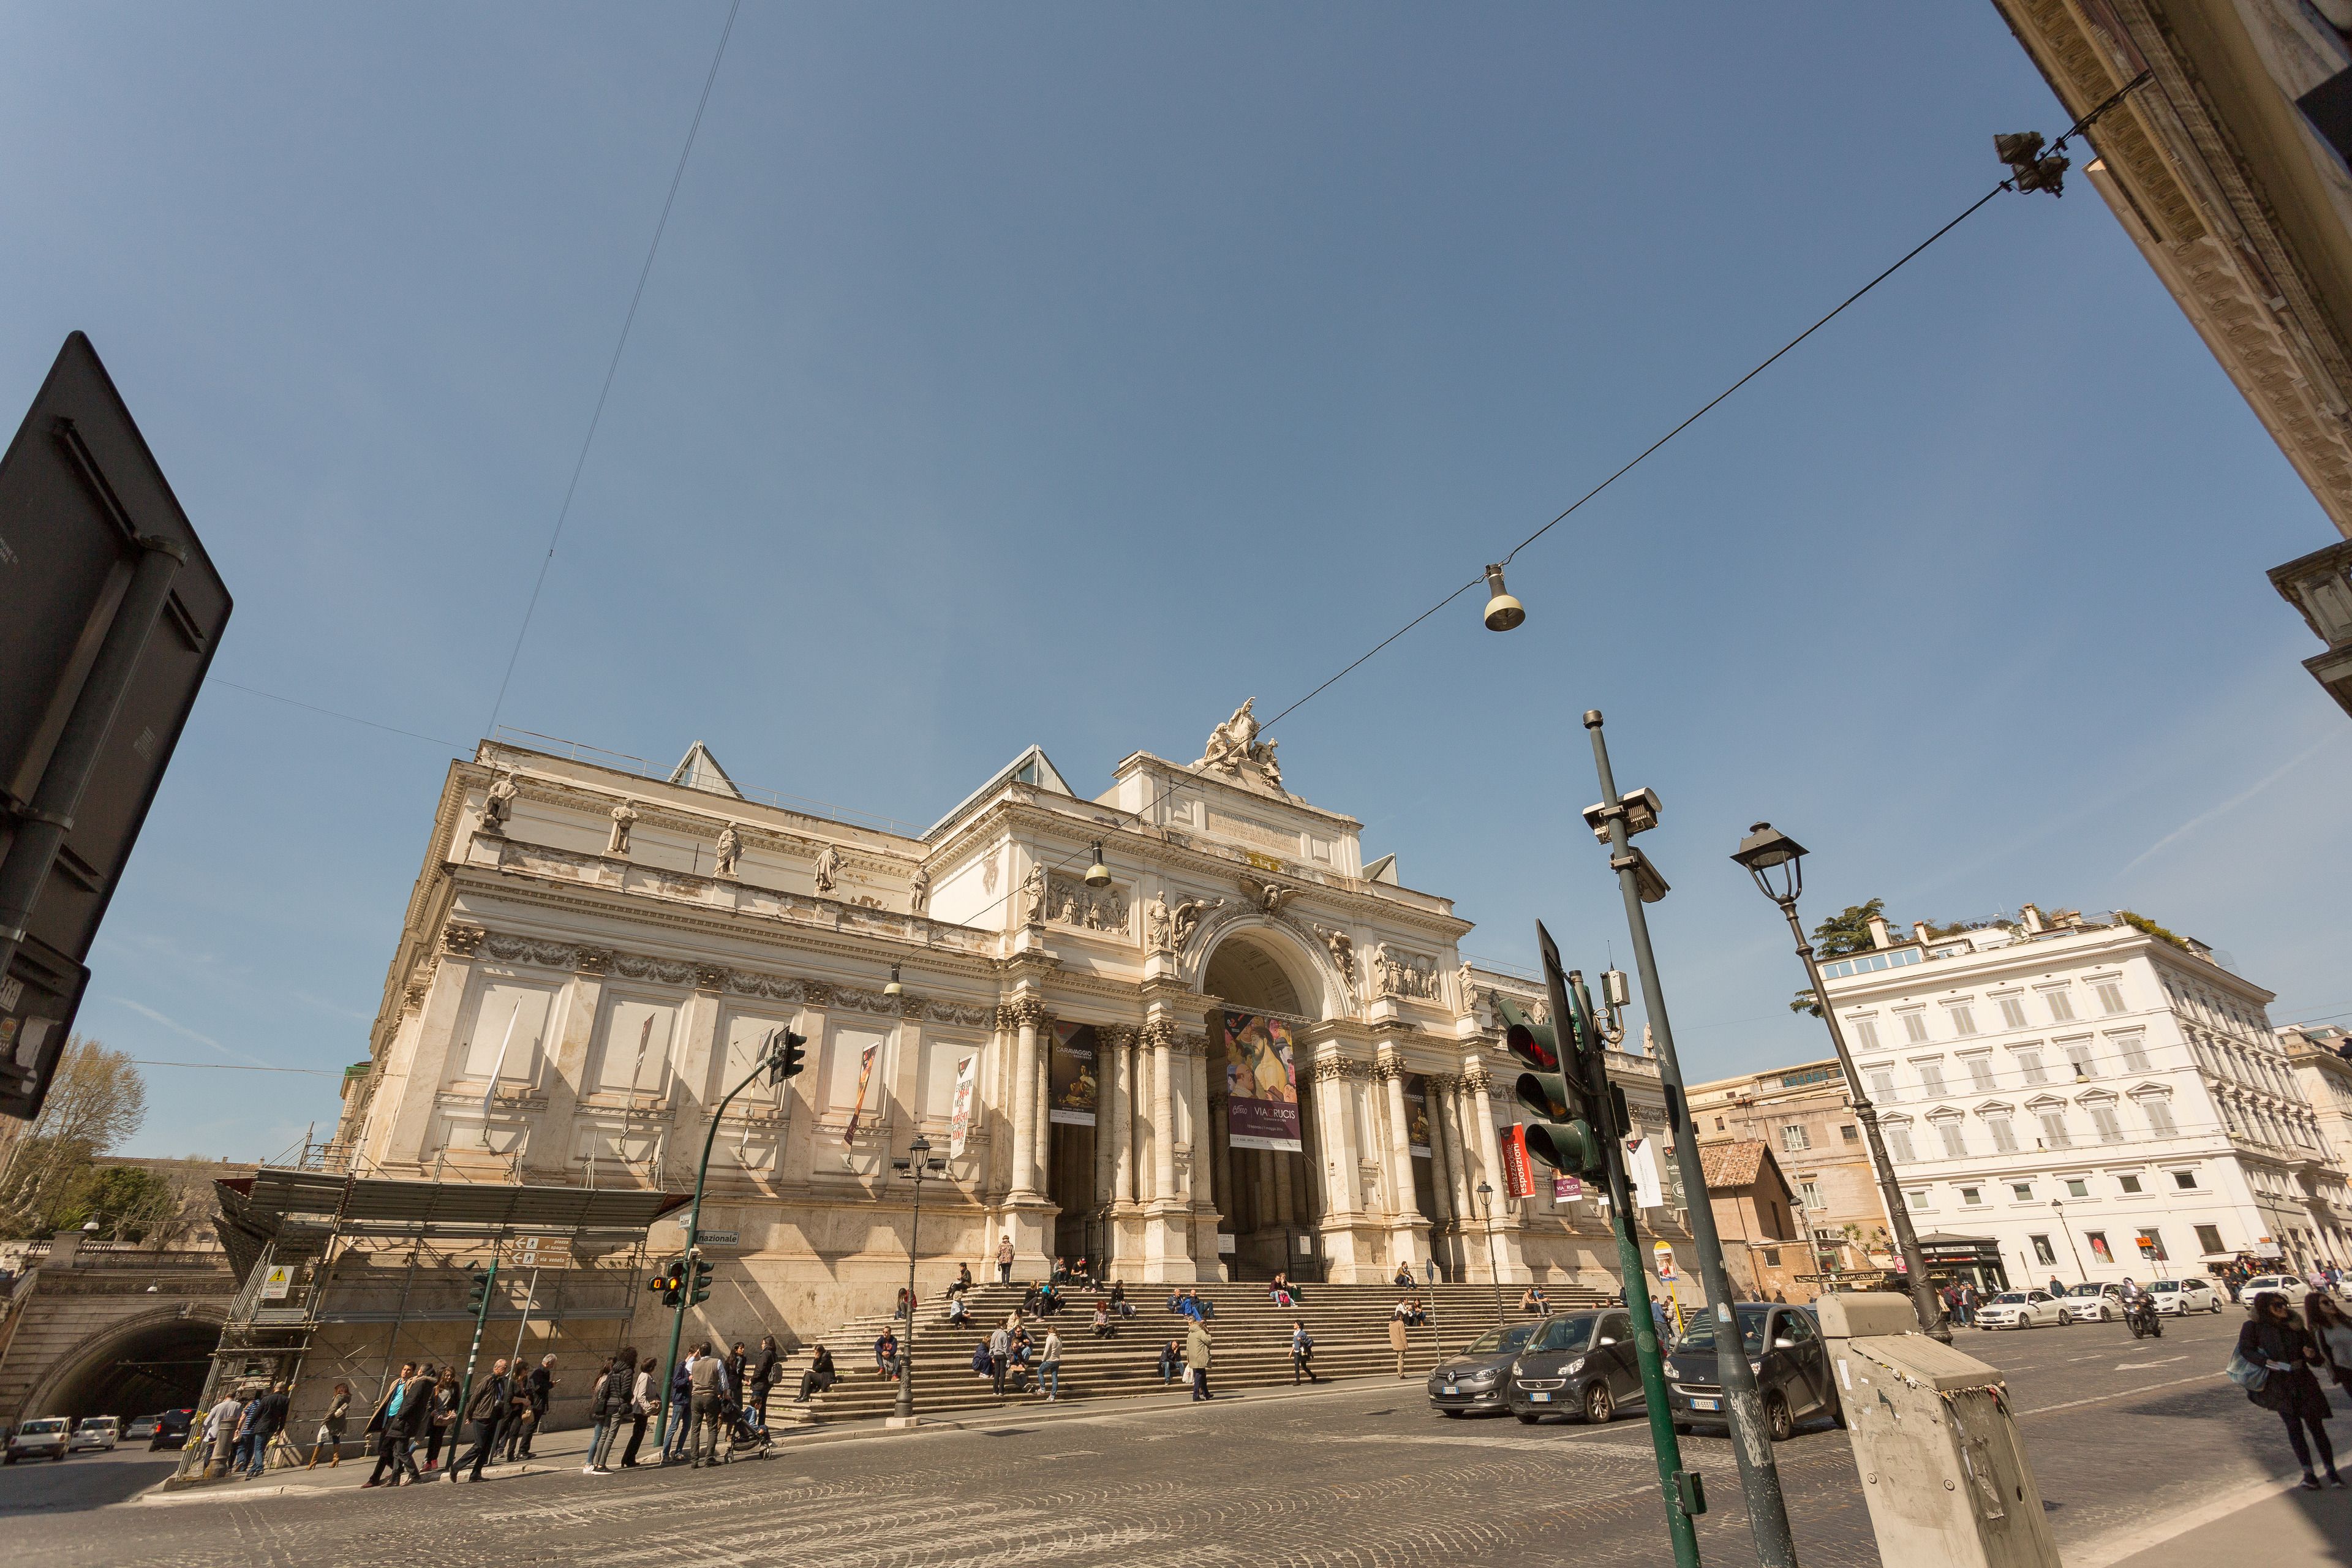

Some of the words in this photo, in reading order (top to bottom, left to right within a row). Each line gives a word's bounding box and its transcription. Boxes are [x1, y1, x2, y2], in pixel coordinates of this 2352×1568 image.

[1055, 1047, 1092, 1057] CARAVAGGIO
[1513, 1143, 1528, 1194] esposizioni
[654, 1280, 660, 1288] 0
